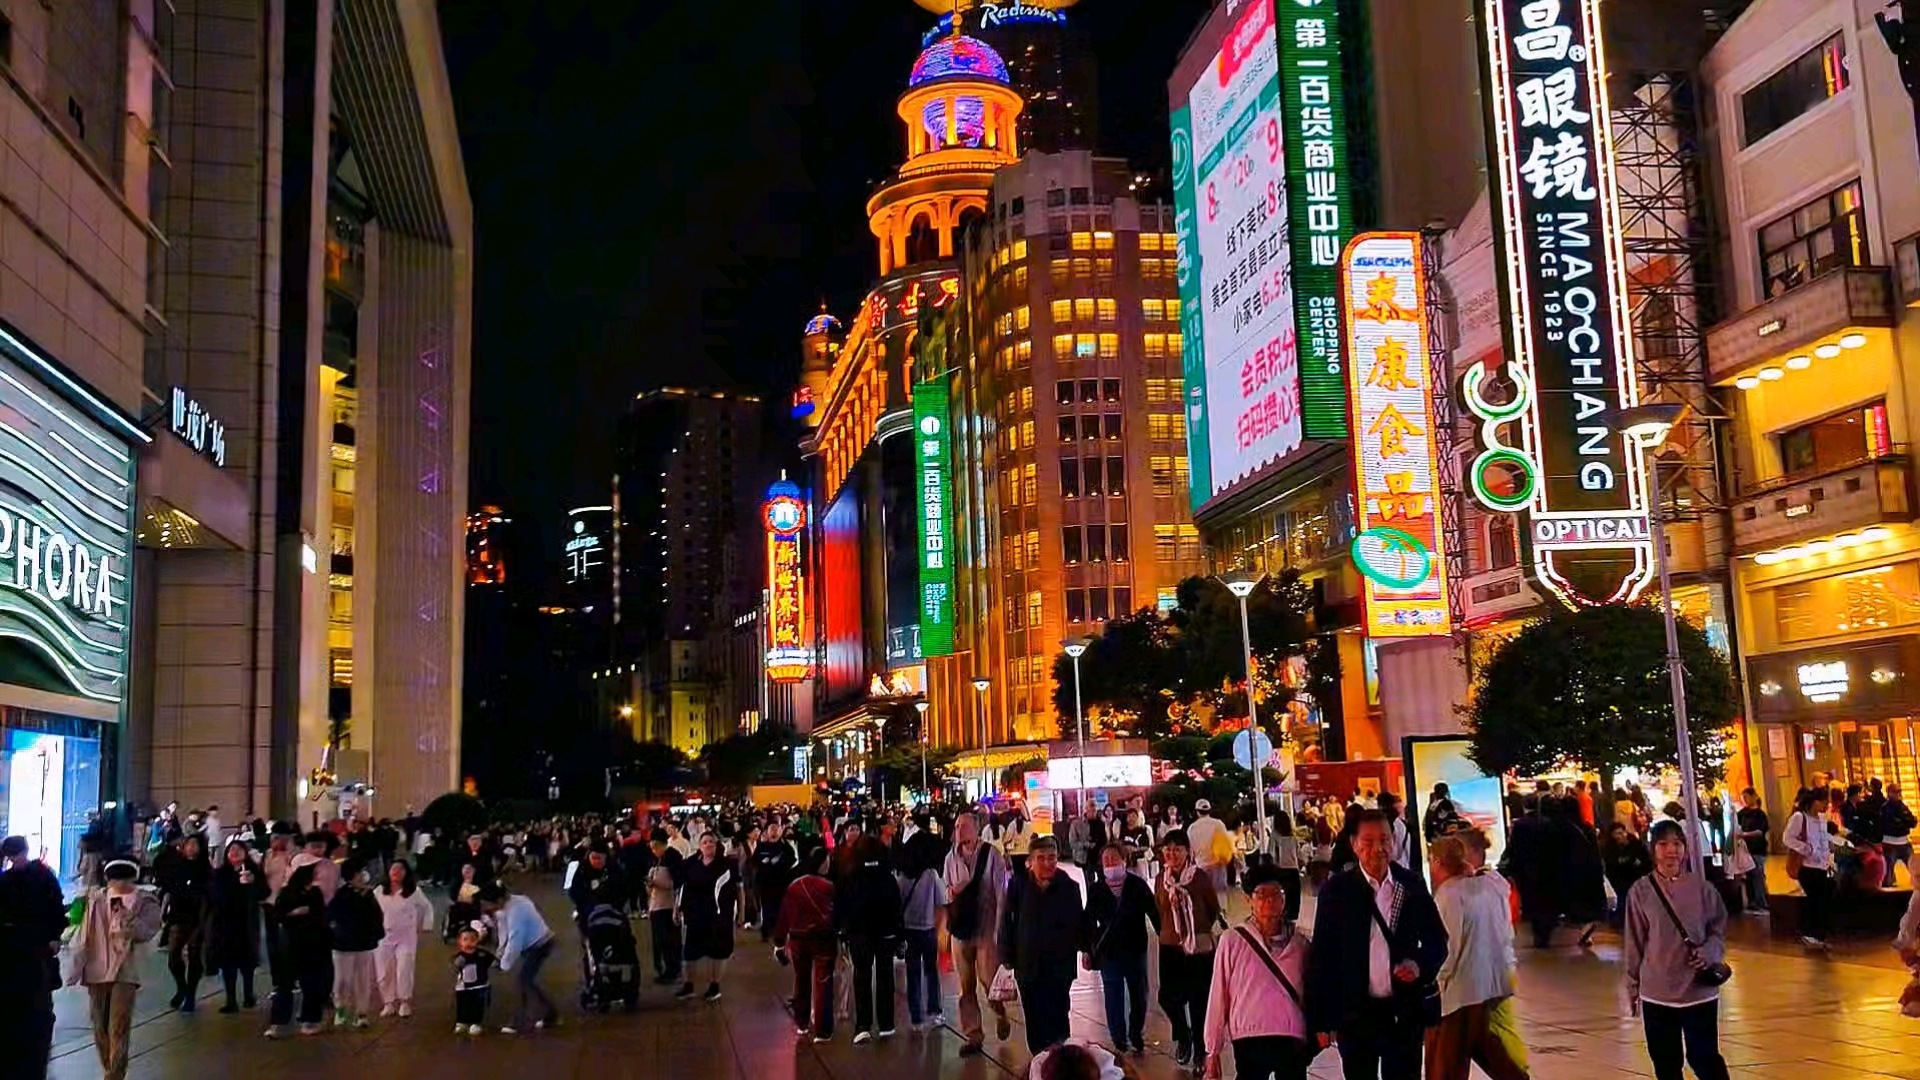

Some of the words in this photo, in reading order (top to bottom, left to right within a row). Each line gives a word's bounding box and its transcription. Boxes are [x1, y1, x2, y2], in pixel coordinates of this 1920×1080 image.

[1294, 18, 1340, 266] 第一百货商业中心
[1536, 213, 1558, 278] SINCE
[1309, 296, 1325, 357] CENTER
[1323, 296, 1340, 375] SHOPPING
[1543, 290, 1563, 342] 1923
[1557, 212, 1615, 491] MAOCHANG
[1358, 271, 1426, 521] 泰康食品
[1536, 519, 1649, 541] OPTICAL
